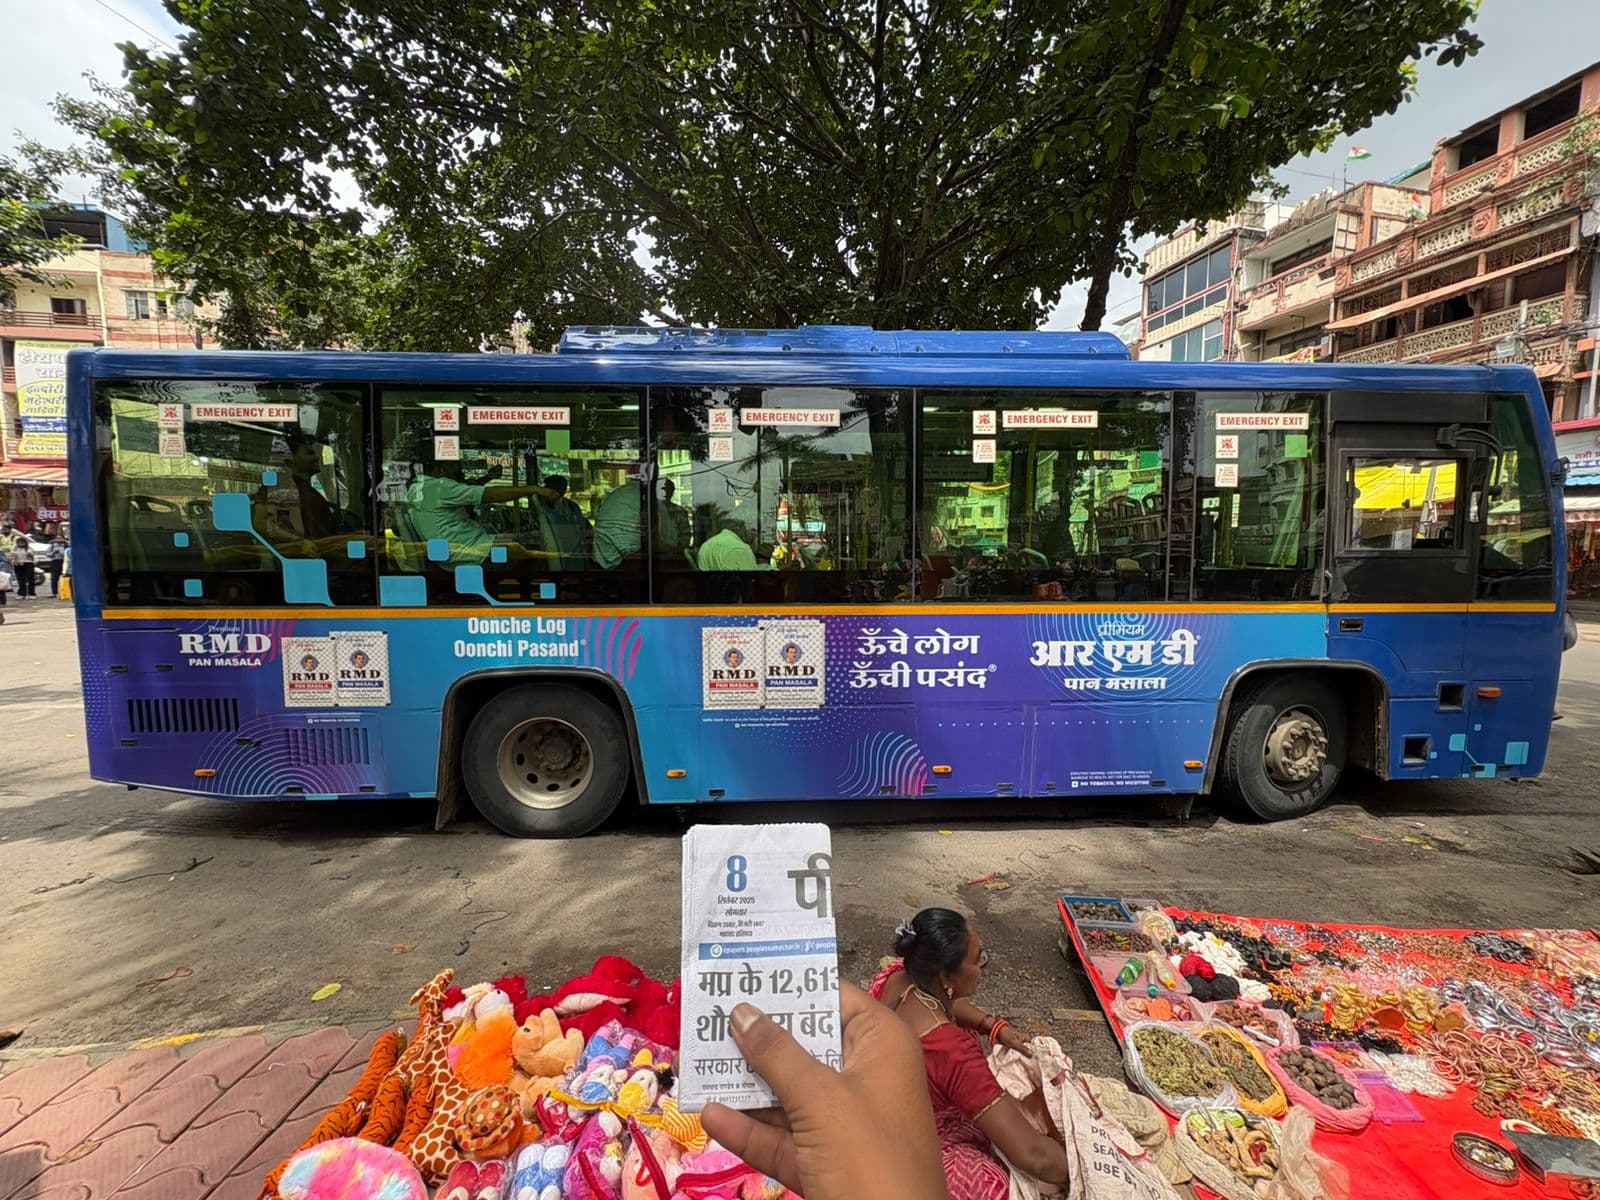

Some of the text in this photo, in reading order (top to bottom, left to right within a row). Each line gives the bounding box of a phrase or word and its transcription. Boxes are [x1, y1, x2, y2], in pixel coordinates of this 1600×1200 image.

[196, 407, 292, 417] EMERGENCY EXIT
[472, 410, 564, 420] EMERGENCY EXIT
[746, 412, 835, 422] EMERGENCY EXIT
[1007, 414, 1093, 424] EMERGENCY EXIT
[1220, 416, 1304, 425] EMERGENCY EXIT
[467, 616, 567, 635] Oonche Log
[178, 633, 271, 653] RMD
[857, 626, 981, 655] ऊँचे लोग
[454, 639, 579, 657] Oonchi Pasand
[1029, 629, 1198, 672] आर एम डी
[189, 657, 262, 667] PAN MASALA
[291, 672, 329, 681] RMD
[340, 669, 380, 679] RMD
[712, 669, 756, 679] RMD
[768, 665, 815, 676] RMD
[848, 660, 988, 688] ऊँची पसंद
[1064, 676, 1168, 690] पान मसाला
[726, 855, 747, 892] 8
[739, 896, 755, 904] 2025
[698, 962, 839, 998] मप्र के 12,613
[799, 1003, 834, 1038] बंद
[693, 1057, 744, 1076] सरकार
[1093, 1161, 1120, 1178] USE
